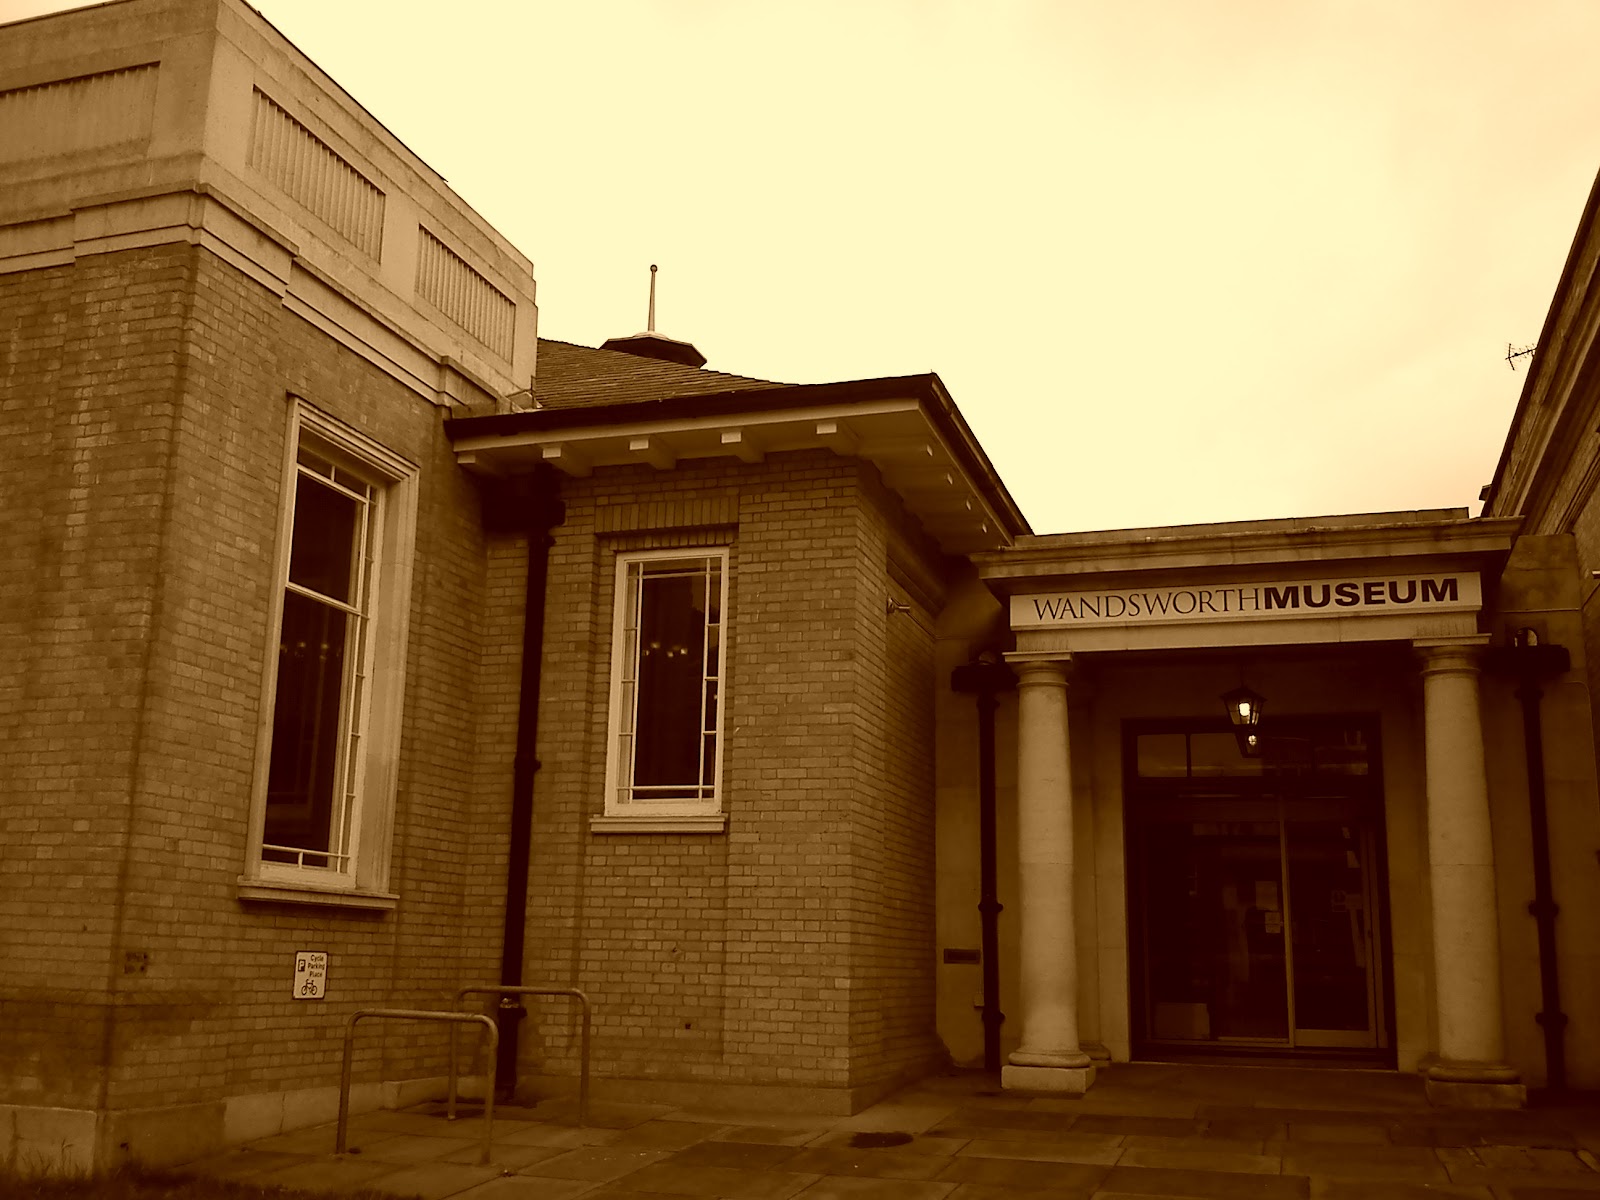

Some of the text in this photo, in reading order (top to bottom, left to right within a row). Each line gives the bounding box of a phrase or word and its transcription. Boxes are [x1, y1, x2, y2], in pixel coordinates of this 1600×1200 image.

[1033, 578, 1459, 621] WANDSWORTH MUSEUM
[311, 954, 324, 962] Cycle
[298, 960, 305, 971] P
